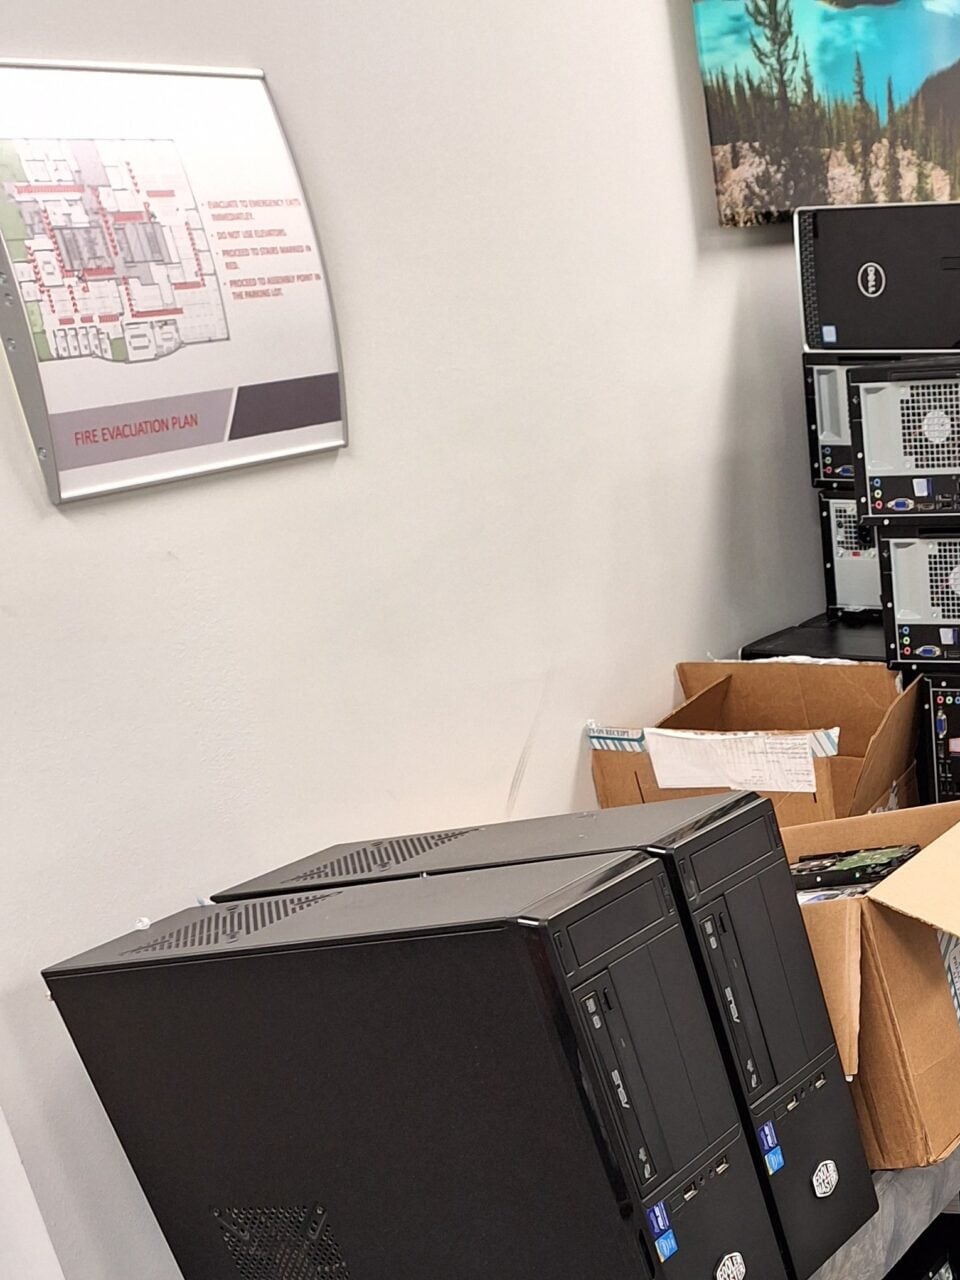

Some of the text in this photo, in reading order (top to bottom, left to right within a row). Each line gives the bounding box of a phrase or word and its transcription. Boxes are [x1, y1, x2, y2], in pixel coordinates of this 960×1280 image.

[867, 266, 876, 294] DELL
[74, 414, 198, 446] FIRE EVACUATION PLAN
[724, 986, 741, 1023] ASUS
[611, 1069, 630, 1109] ASUS
[720, 1255, 744, 1280] COOLER
